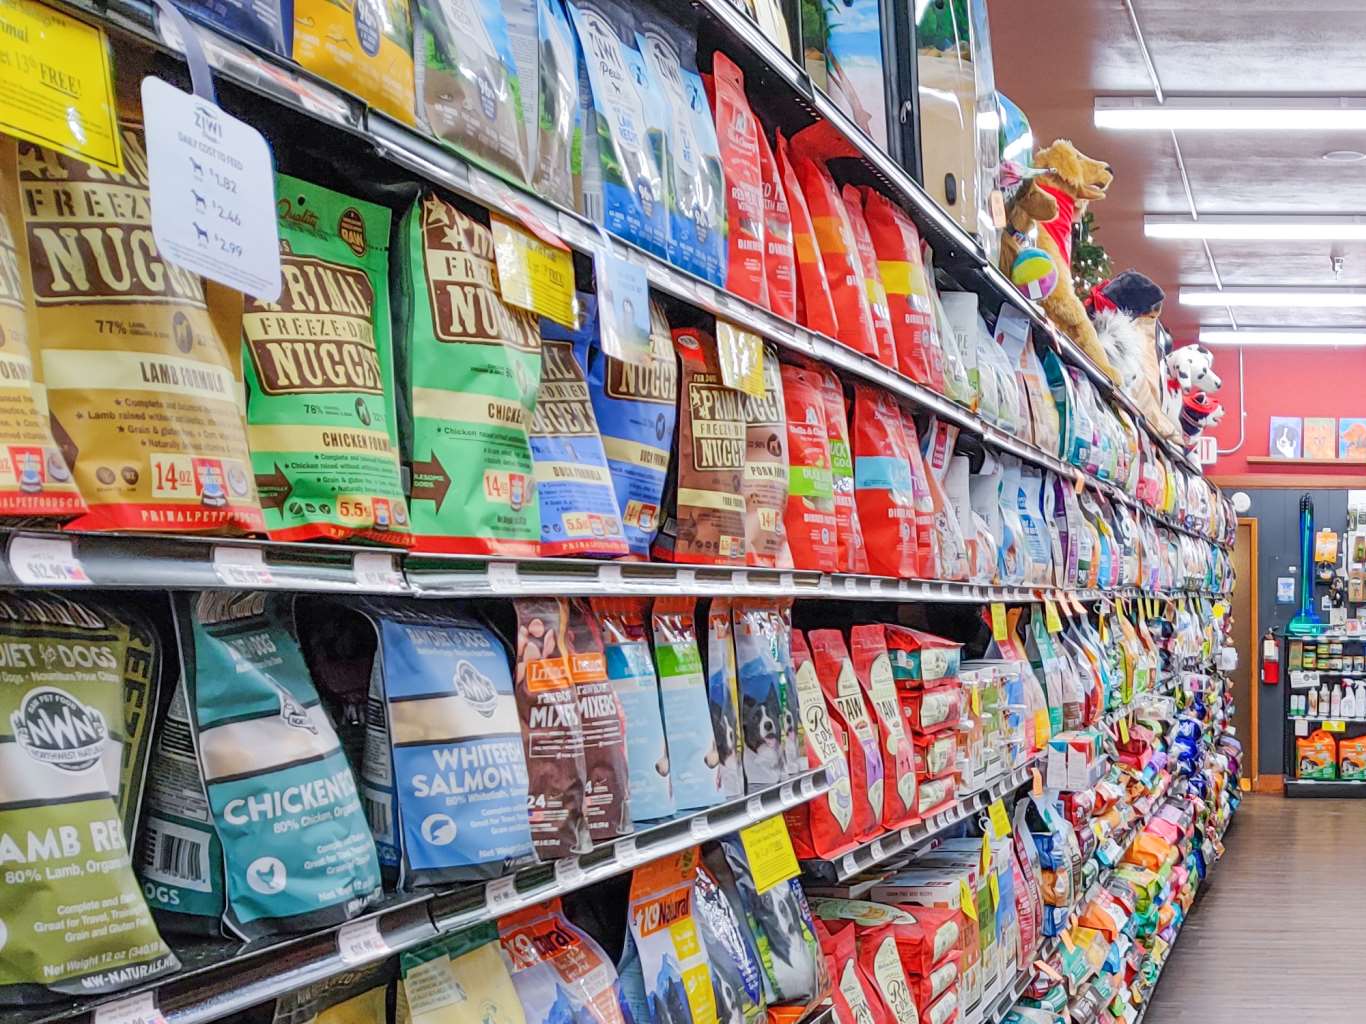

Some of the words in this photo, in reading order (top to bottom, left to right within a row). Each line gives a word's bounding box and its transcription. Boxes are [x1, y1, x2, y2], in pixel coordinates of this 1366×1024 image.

[40, 61, 82, 97] FREE!
[140, 361, 179, 387] LAMB
[88, 410, 117, 421] Lamb
[322, 432, 369, 450] CHICKEN
[154, 462, 178, 491] 14
[58, 644, 118, 669] DOGS
[26, 705, 98, 750] NWN
[412, 767, 512, 798] SALMON
[223, 774, 340, 827] CHICKEN
[5, 866, 42, 884] 80%
[45, 861, 85, 882] Lamb,
[57, 900, 101, 915] Complete
[33, 918, 65, 933] Great
[66, 916, 81, 929] for
[64, 930, 91, 944] Grain
[91, 926, 109, 939] and
[43, 964, 66, 977] Net
[66, 957, 100, 974] Weight
[101, 952, 114, 965] 12
